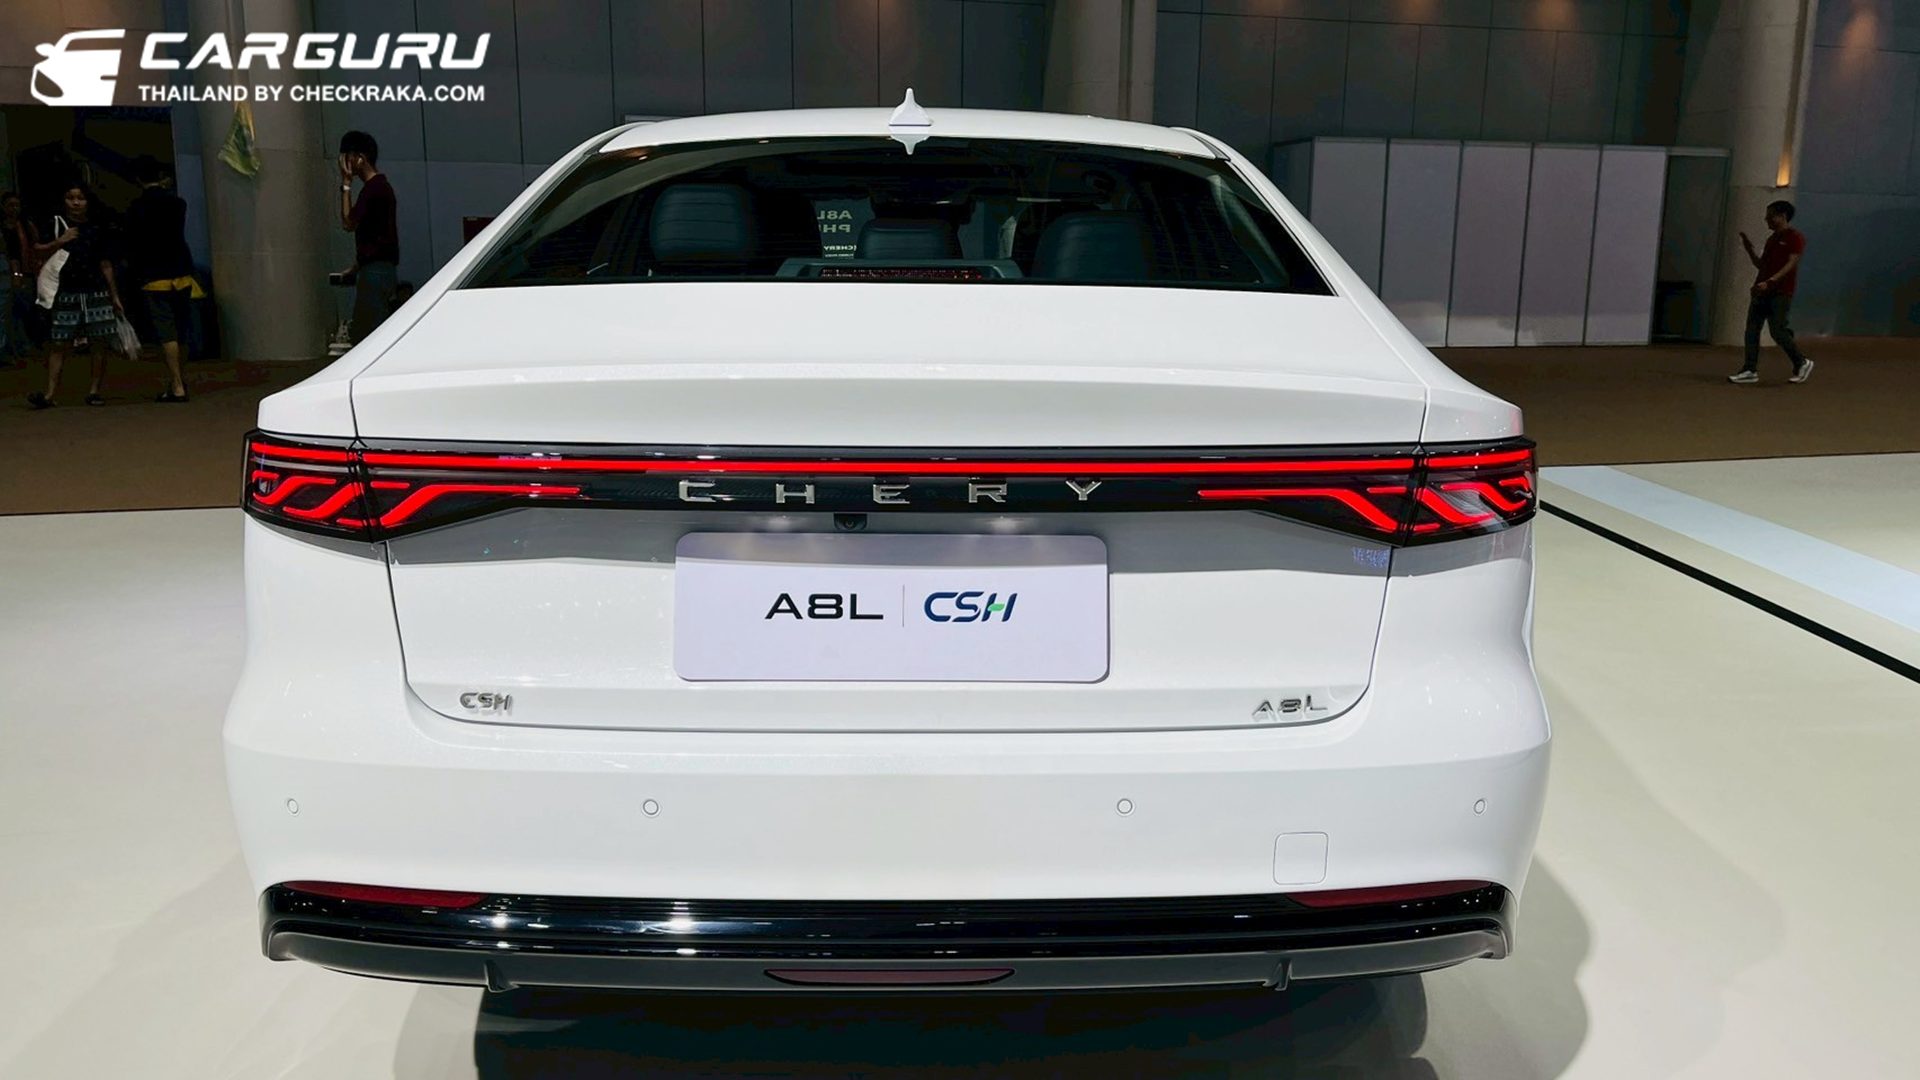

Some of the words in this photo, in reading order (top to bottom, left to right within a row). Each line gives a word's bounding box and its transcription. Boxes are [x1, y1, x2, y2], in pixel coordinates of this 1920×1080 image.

[678, 479, 1102, 504] CHERY
[764, 592, 884, 620] A8L
[923, 590, 1018, 623] CSH
[459, 692, 513, 712] CSH
[1252, 694, 1328, 717] A8L
